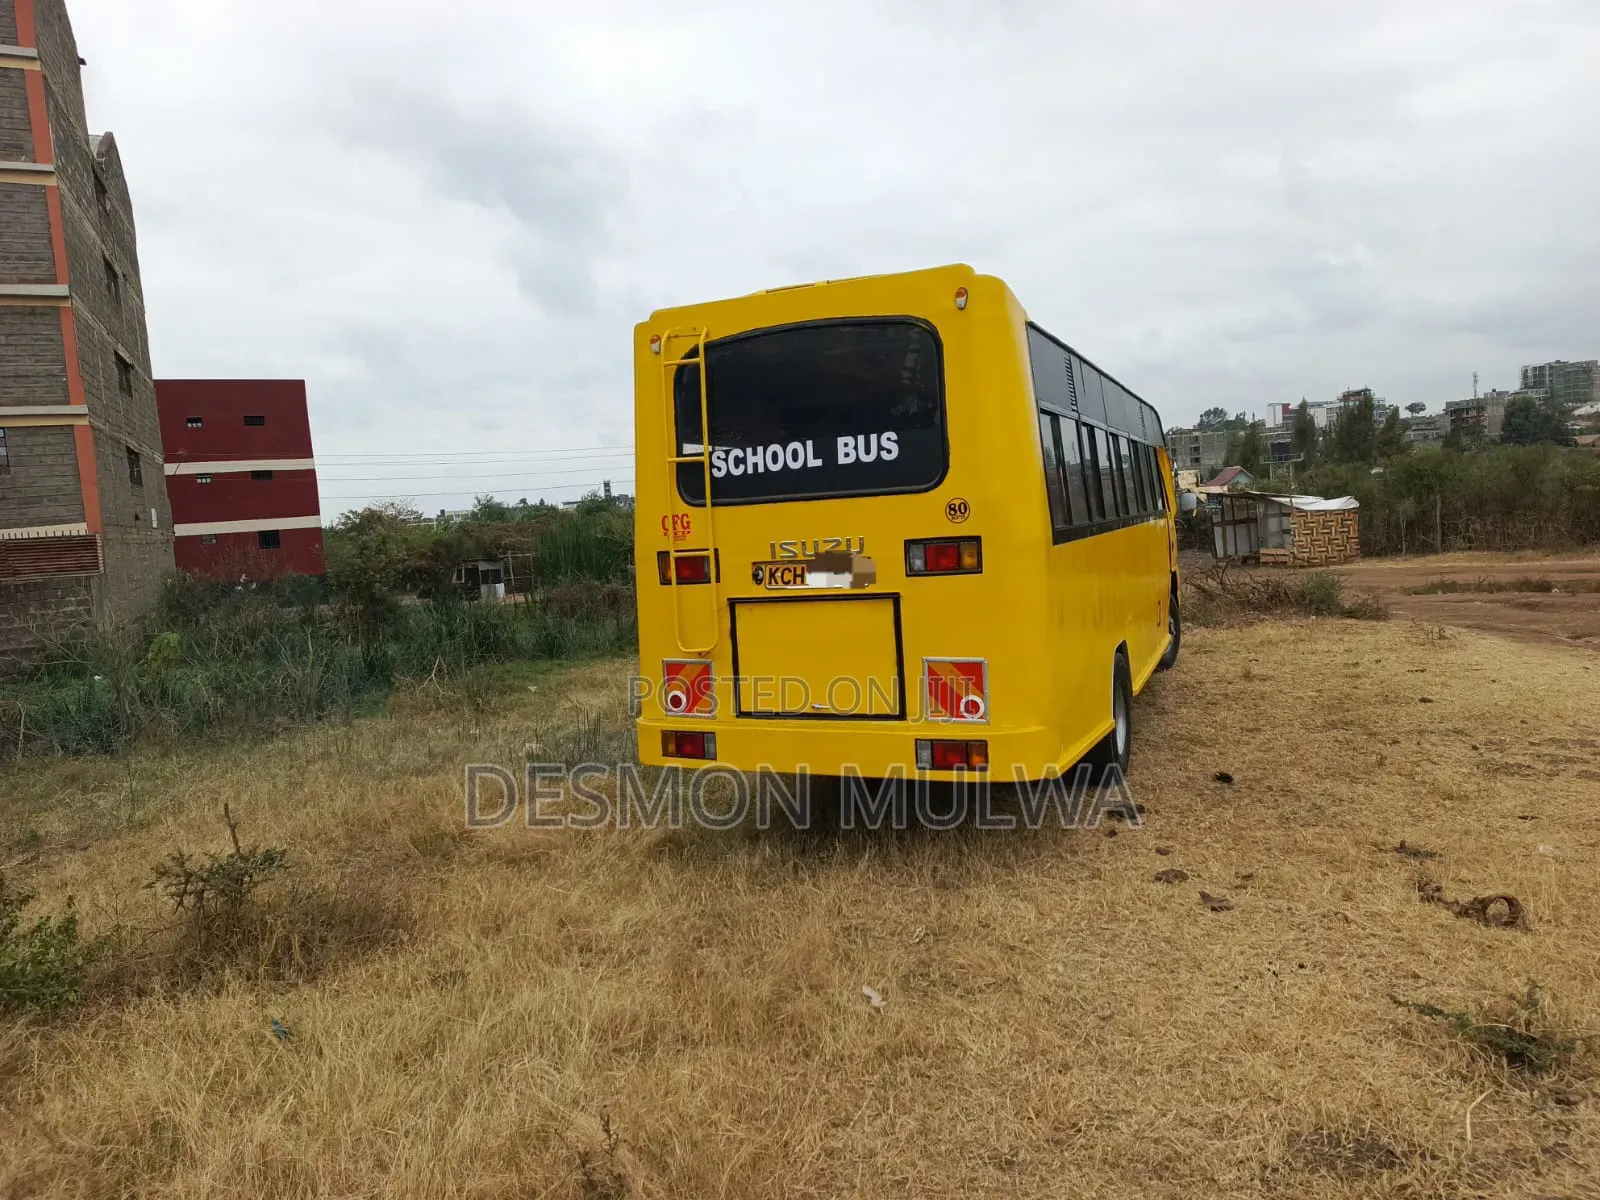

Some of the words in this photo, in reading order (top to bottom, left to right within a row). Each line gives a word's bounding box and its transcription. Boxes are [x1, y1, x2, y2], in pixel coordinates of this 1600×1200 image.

[711, 440, 822, 478] SCHOOL
[837, 431, 899, 465] BUS
[948, 502, 967, 516] 80
[768, 566, 805, 585] KCH
